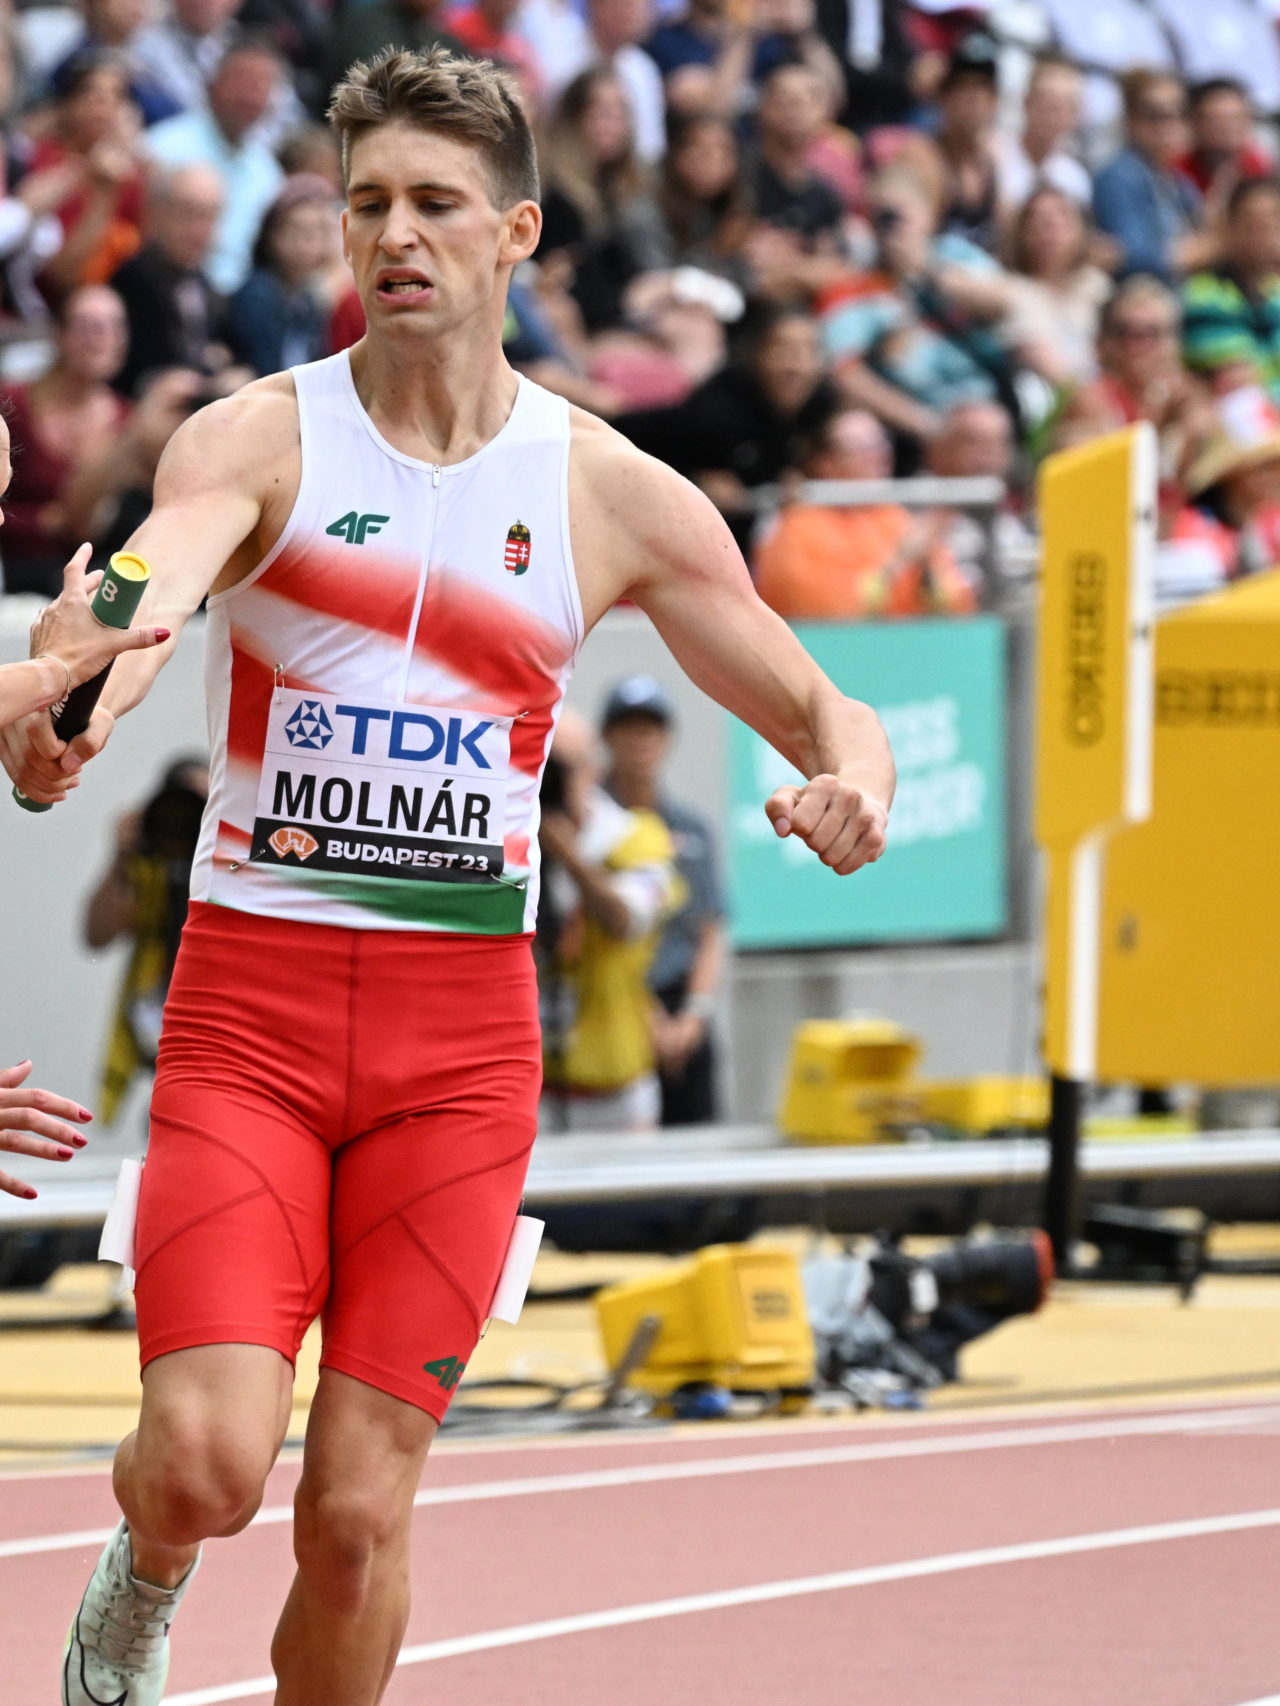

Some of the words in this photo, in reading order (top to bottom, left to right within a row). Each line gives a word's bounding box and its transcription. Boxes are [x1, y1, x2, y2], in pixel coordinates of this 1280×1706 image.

[326, 511, 390, 545] 4F
[335, 704, 496, 770] TDK
[272, 770, 492, 839] MOLNÁR
[326, 840, 460, 868] BUDAPEST
[460, 854, 489, 872] 23
